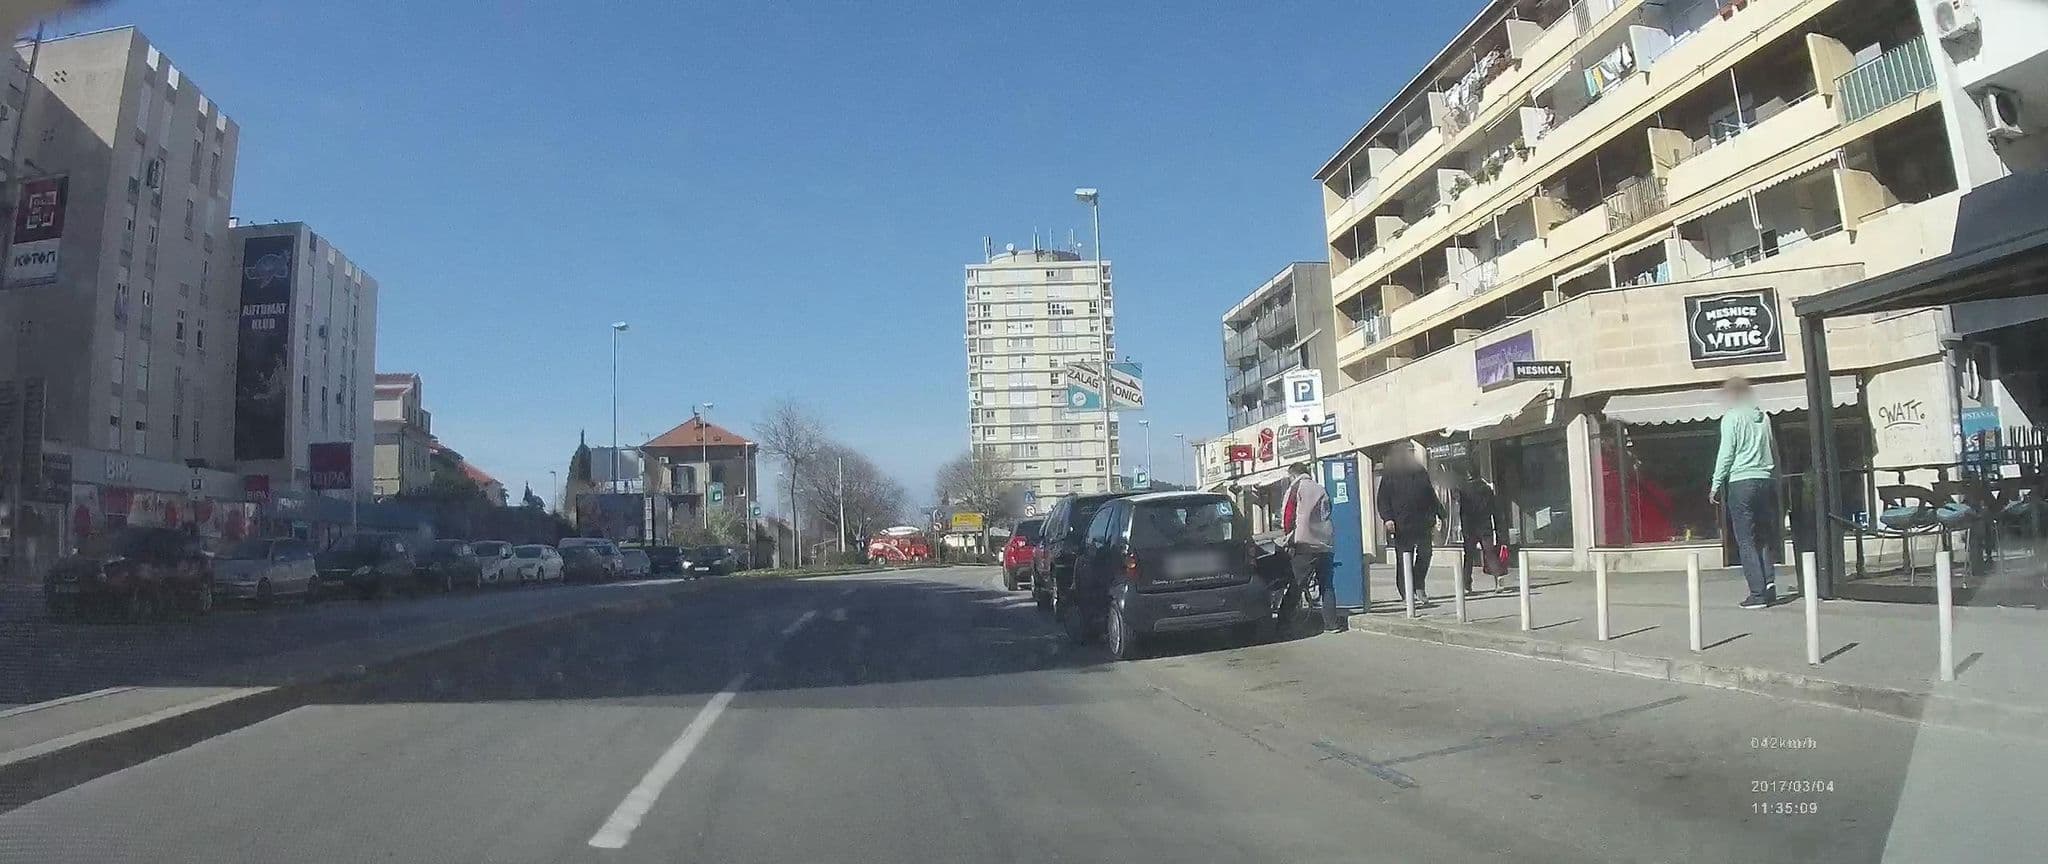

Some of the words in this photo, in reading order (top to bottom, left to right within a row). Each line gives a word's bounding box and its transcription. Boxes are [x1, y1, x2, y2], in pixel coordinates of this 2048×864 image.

[242, 303, 287, 316] AUTOMAT
[1705, 306, 1758, 320] MESNICE
[1706, 325, 1763, 349] VITIĆ
[1516, 365, 1562, 375] MESNICA
[1298, 382, 1310, 400] P
